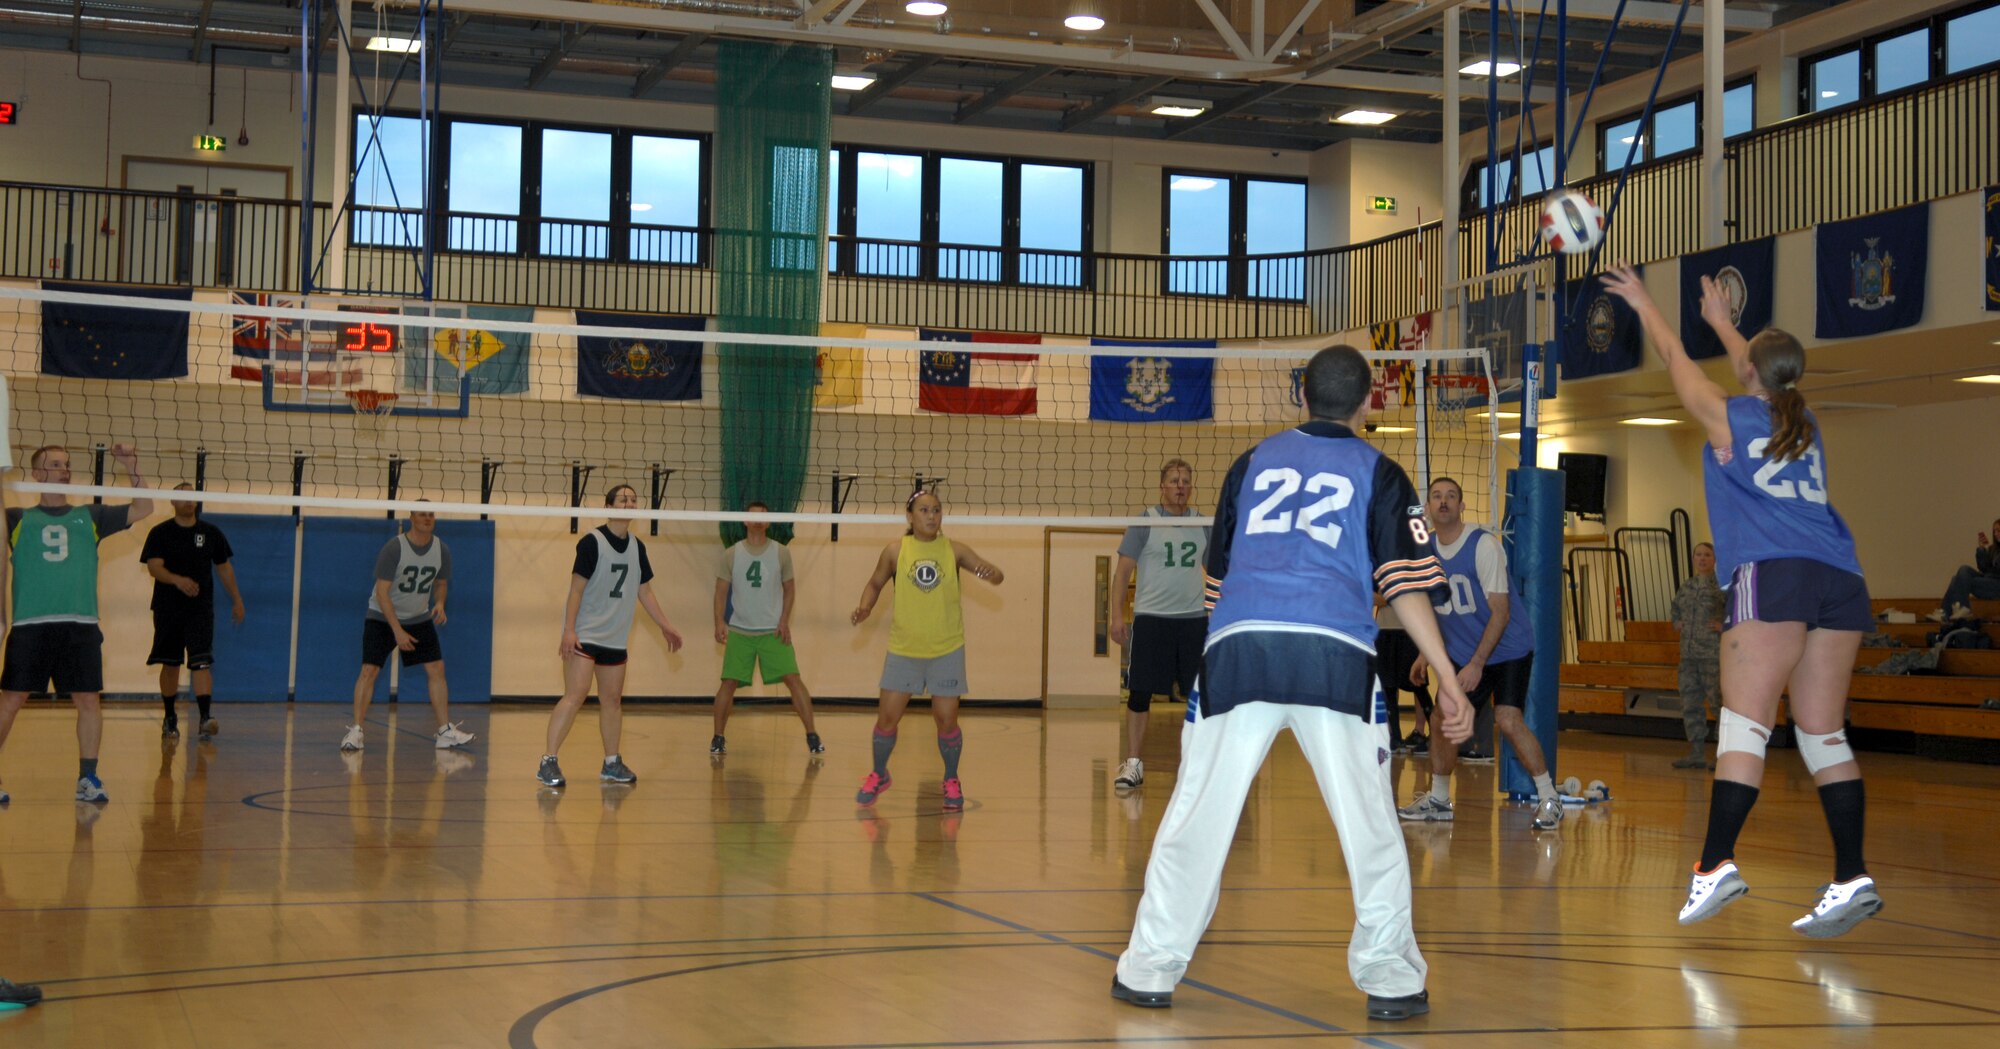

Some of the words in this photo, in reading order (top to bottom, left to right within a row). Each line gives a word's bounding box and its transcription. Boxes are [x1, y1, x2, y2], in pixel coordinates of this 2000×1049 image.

[345, 321, 392, 351] 35
[1747, 437, 1827, 505] 23
[1246, 467, 1354, 549] 22
[42, 524, 69, 562] 9
[1164, 541, 1197, 568] 12
[398, 565, 436, 594] 32
[609, 563, 629, 598] 7
[745, 560, 763, 588] 4
[921, 567, 932, 581] L
[1434, 573, 1477, 615] 0
